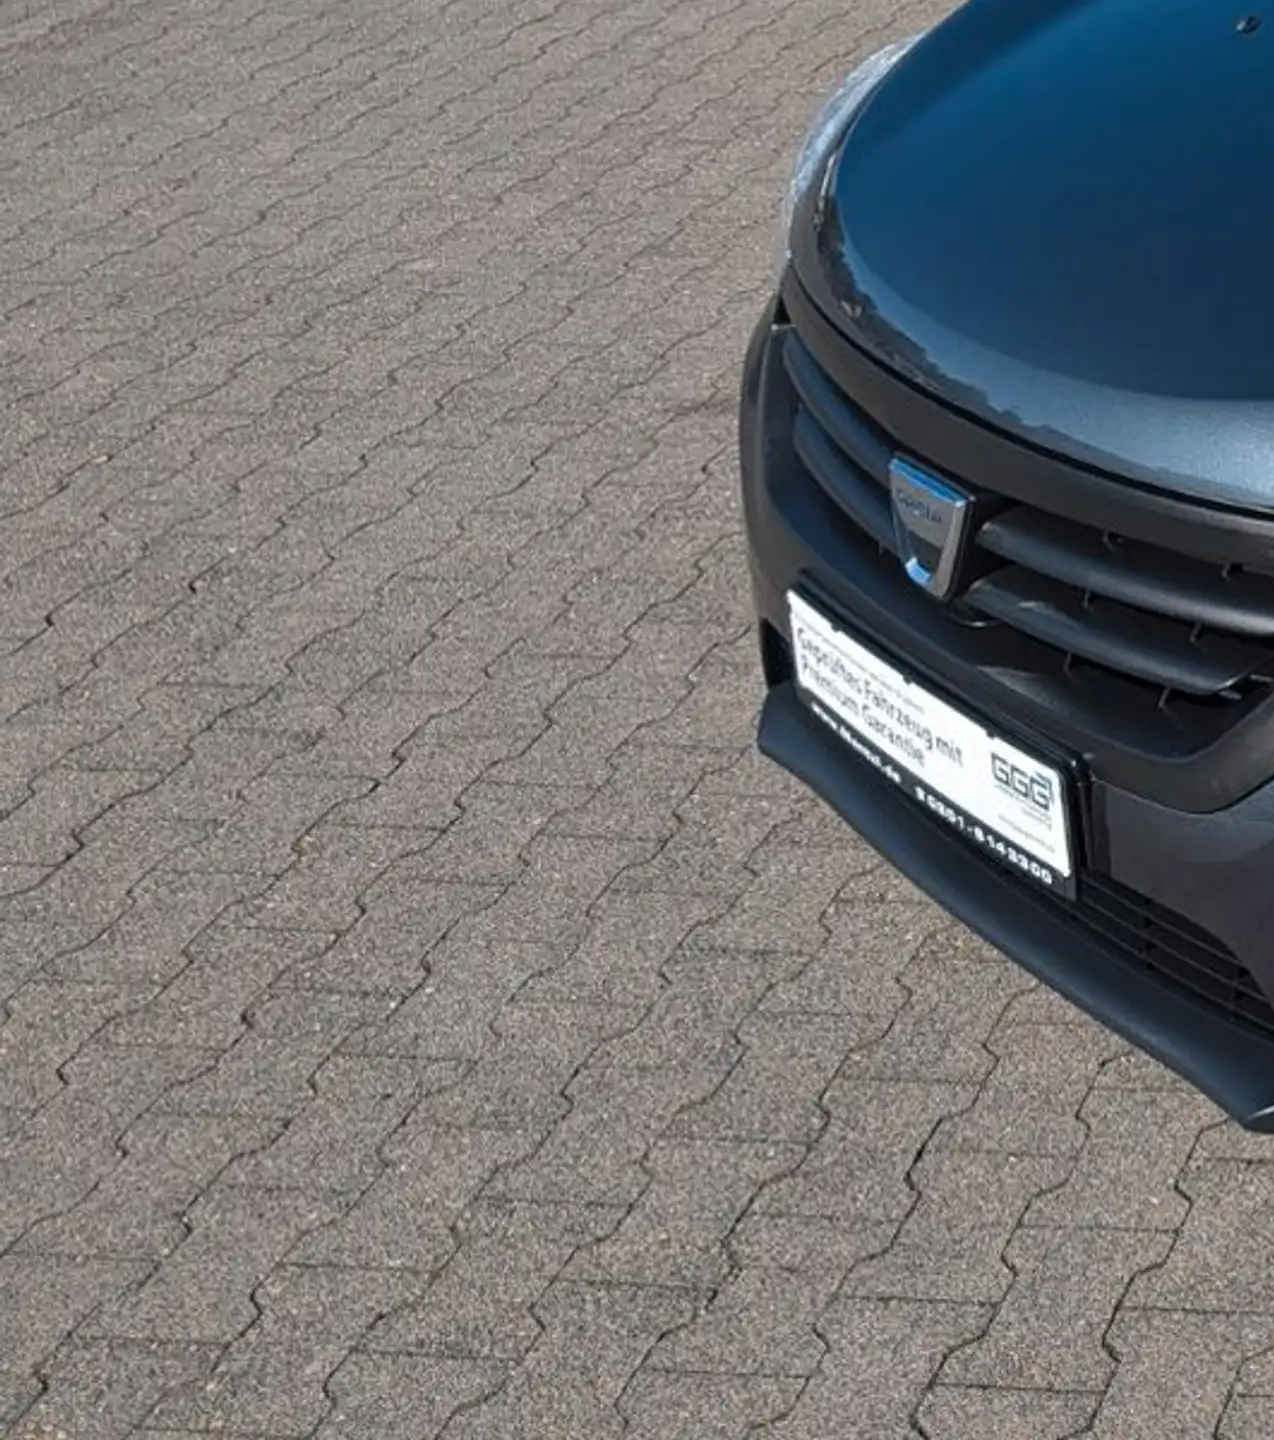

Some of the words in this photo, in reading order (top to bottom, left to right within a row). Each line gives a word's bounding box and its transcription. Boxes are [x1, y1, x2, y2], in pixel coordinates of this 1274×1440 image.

[861, 704, 926, 768] Garantie
[863, 679, 934, 751] Fahrzeug
[935, 736, 965, 768] mit
